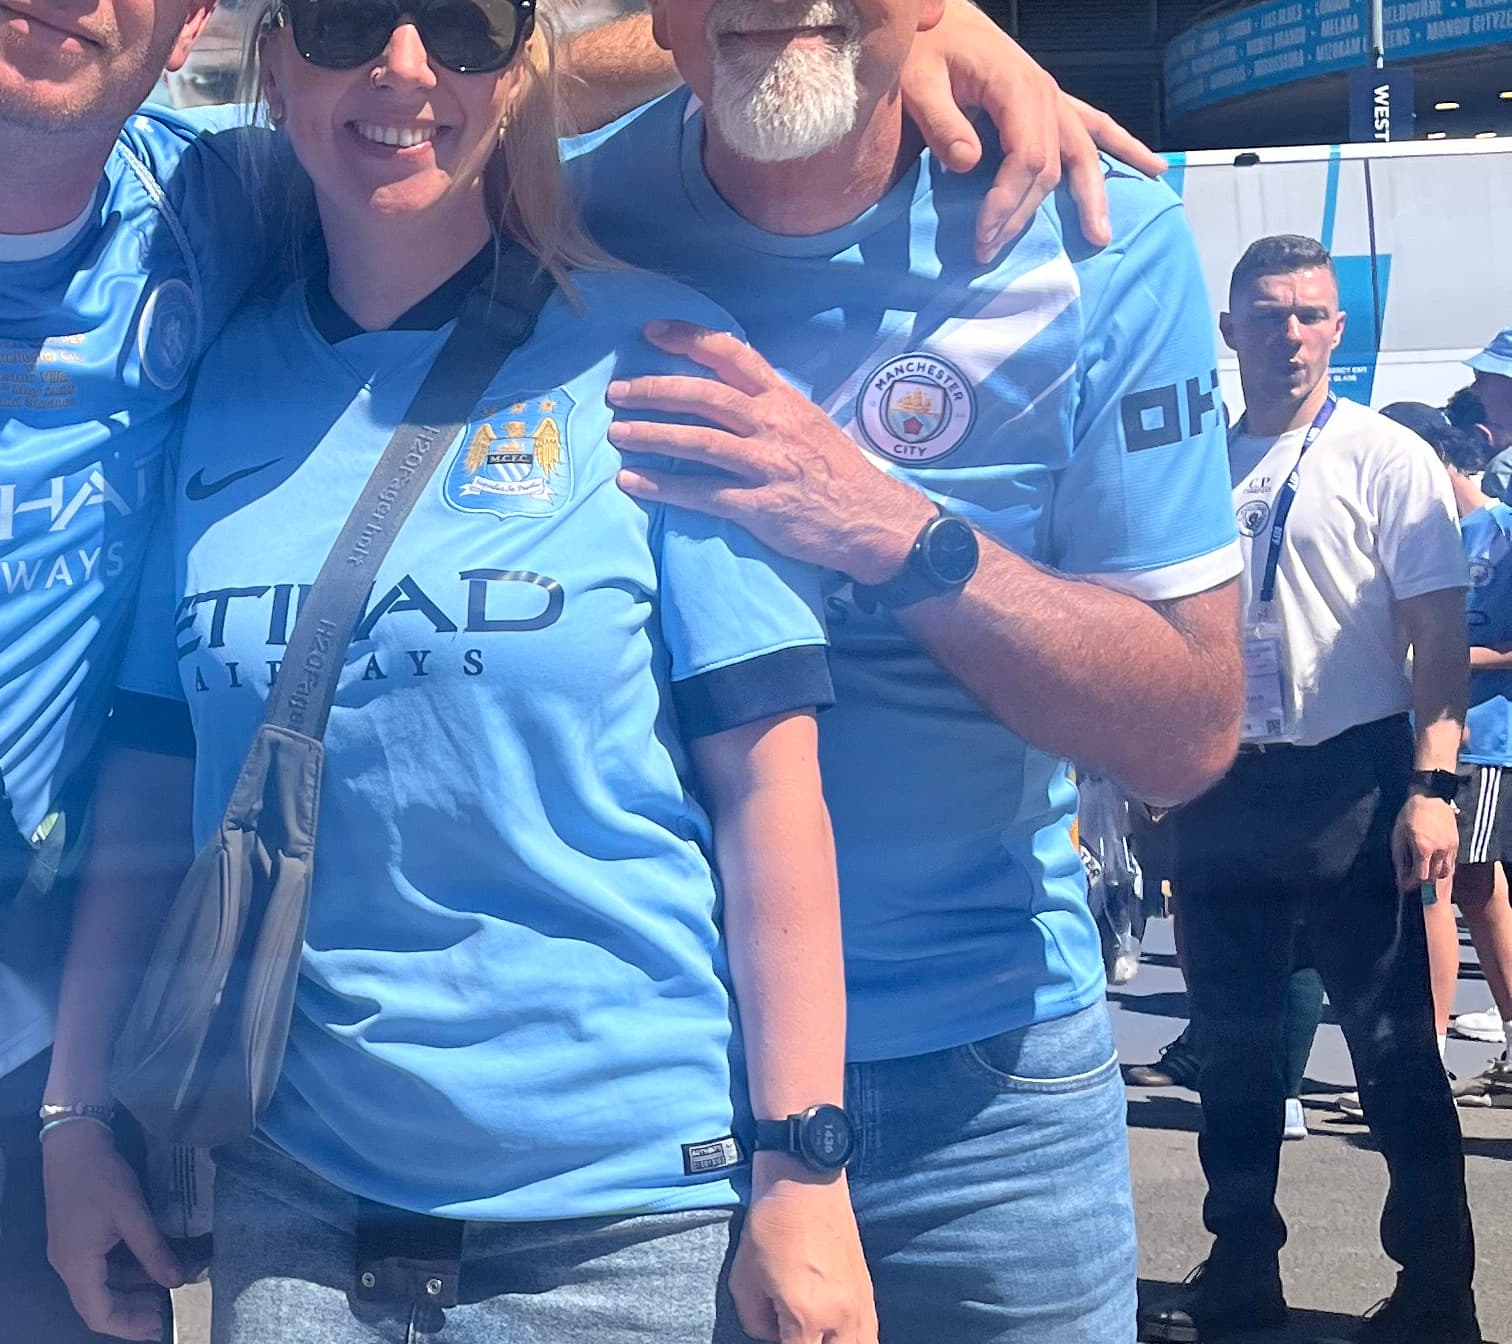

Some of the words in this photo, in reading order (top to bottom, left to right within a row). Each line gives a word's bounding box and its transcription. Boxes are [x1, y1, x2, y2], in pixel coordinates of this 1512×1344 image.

[1373, 83, 1390, 143] WEST
[875, 362, 964, 401] MANCHESTER
[893, 444, 928, 457] CITY
